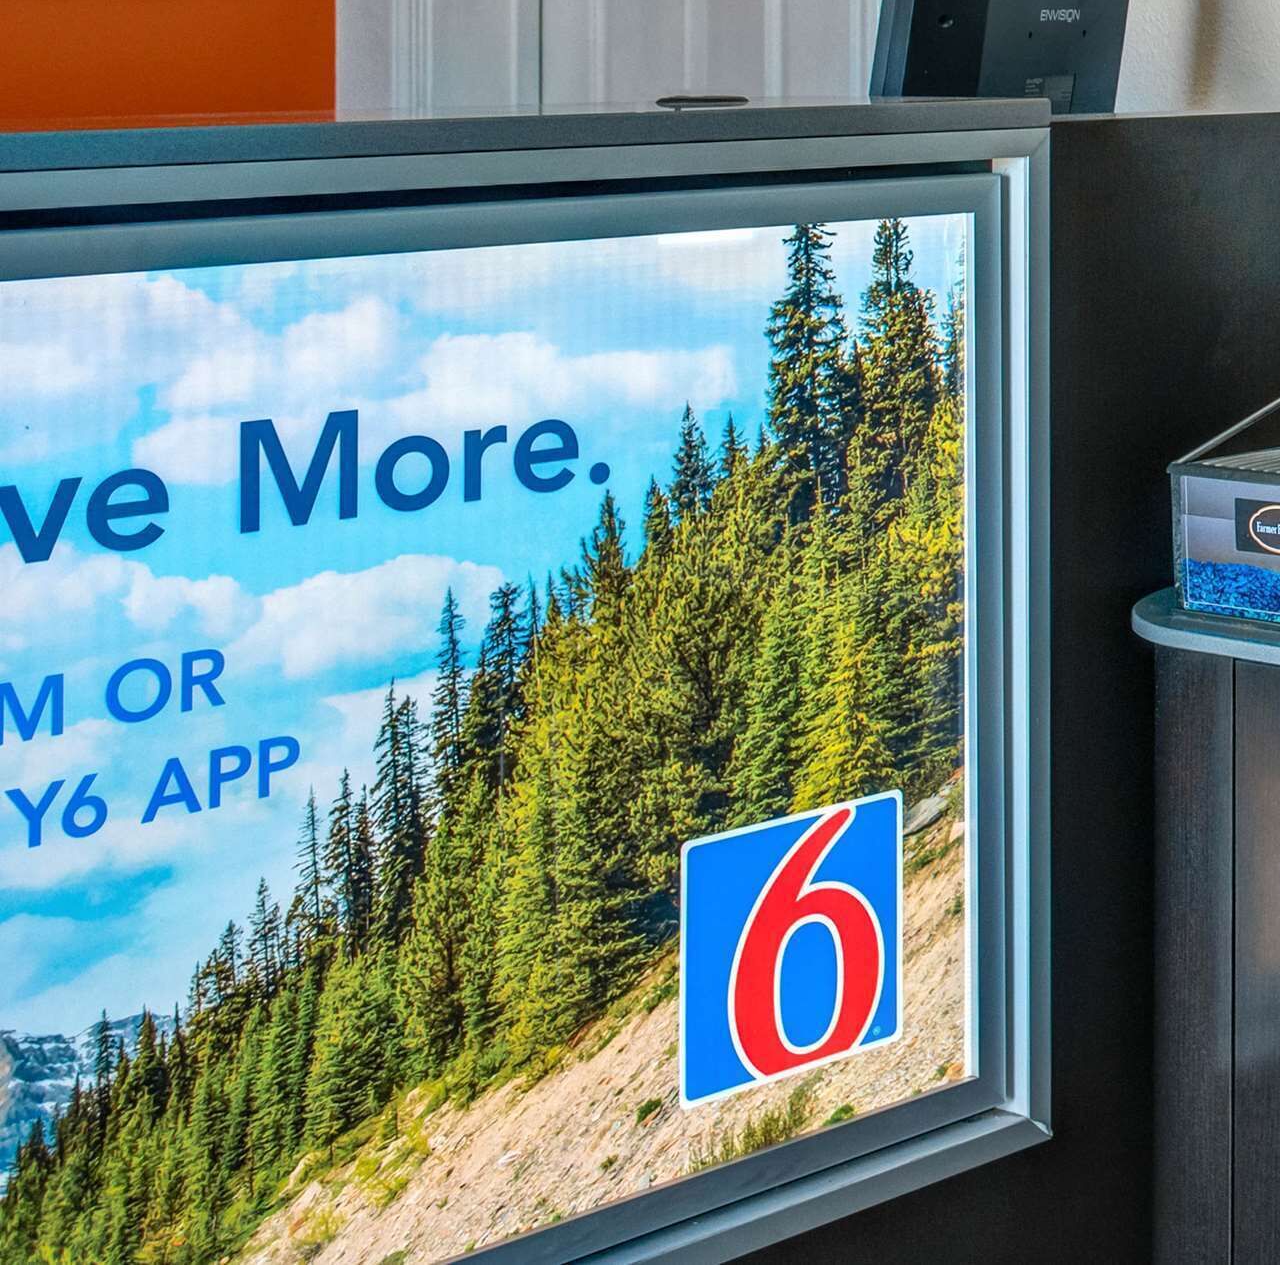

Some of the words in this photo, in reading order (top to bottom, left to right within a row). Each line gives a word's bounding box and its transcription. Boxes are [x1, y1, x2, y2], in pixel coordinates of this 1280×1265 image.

[1040, 9, 1081, 23] ENVISION
[0, 469, 170, 564] ve
[240, 409, 611, 534] More.
[1256, 521, 1277, 534] Farmer
[106, 649, 226, 723] OR
[5, 774, 108, 848] Y6
[141, 736, 300, 824] APP
[732, 807, 882, 1079] 6
